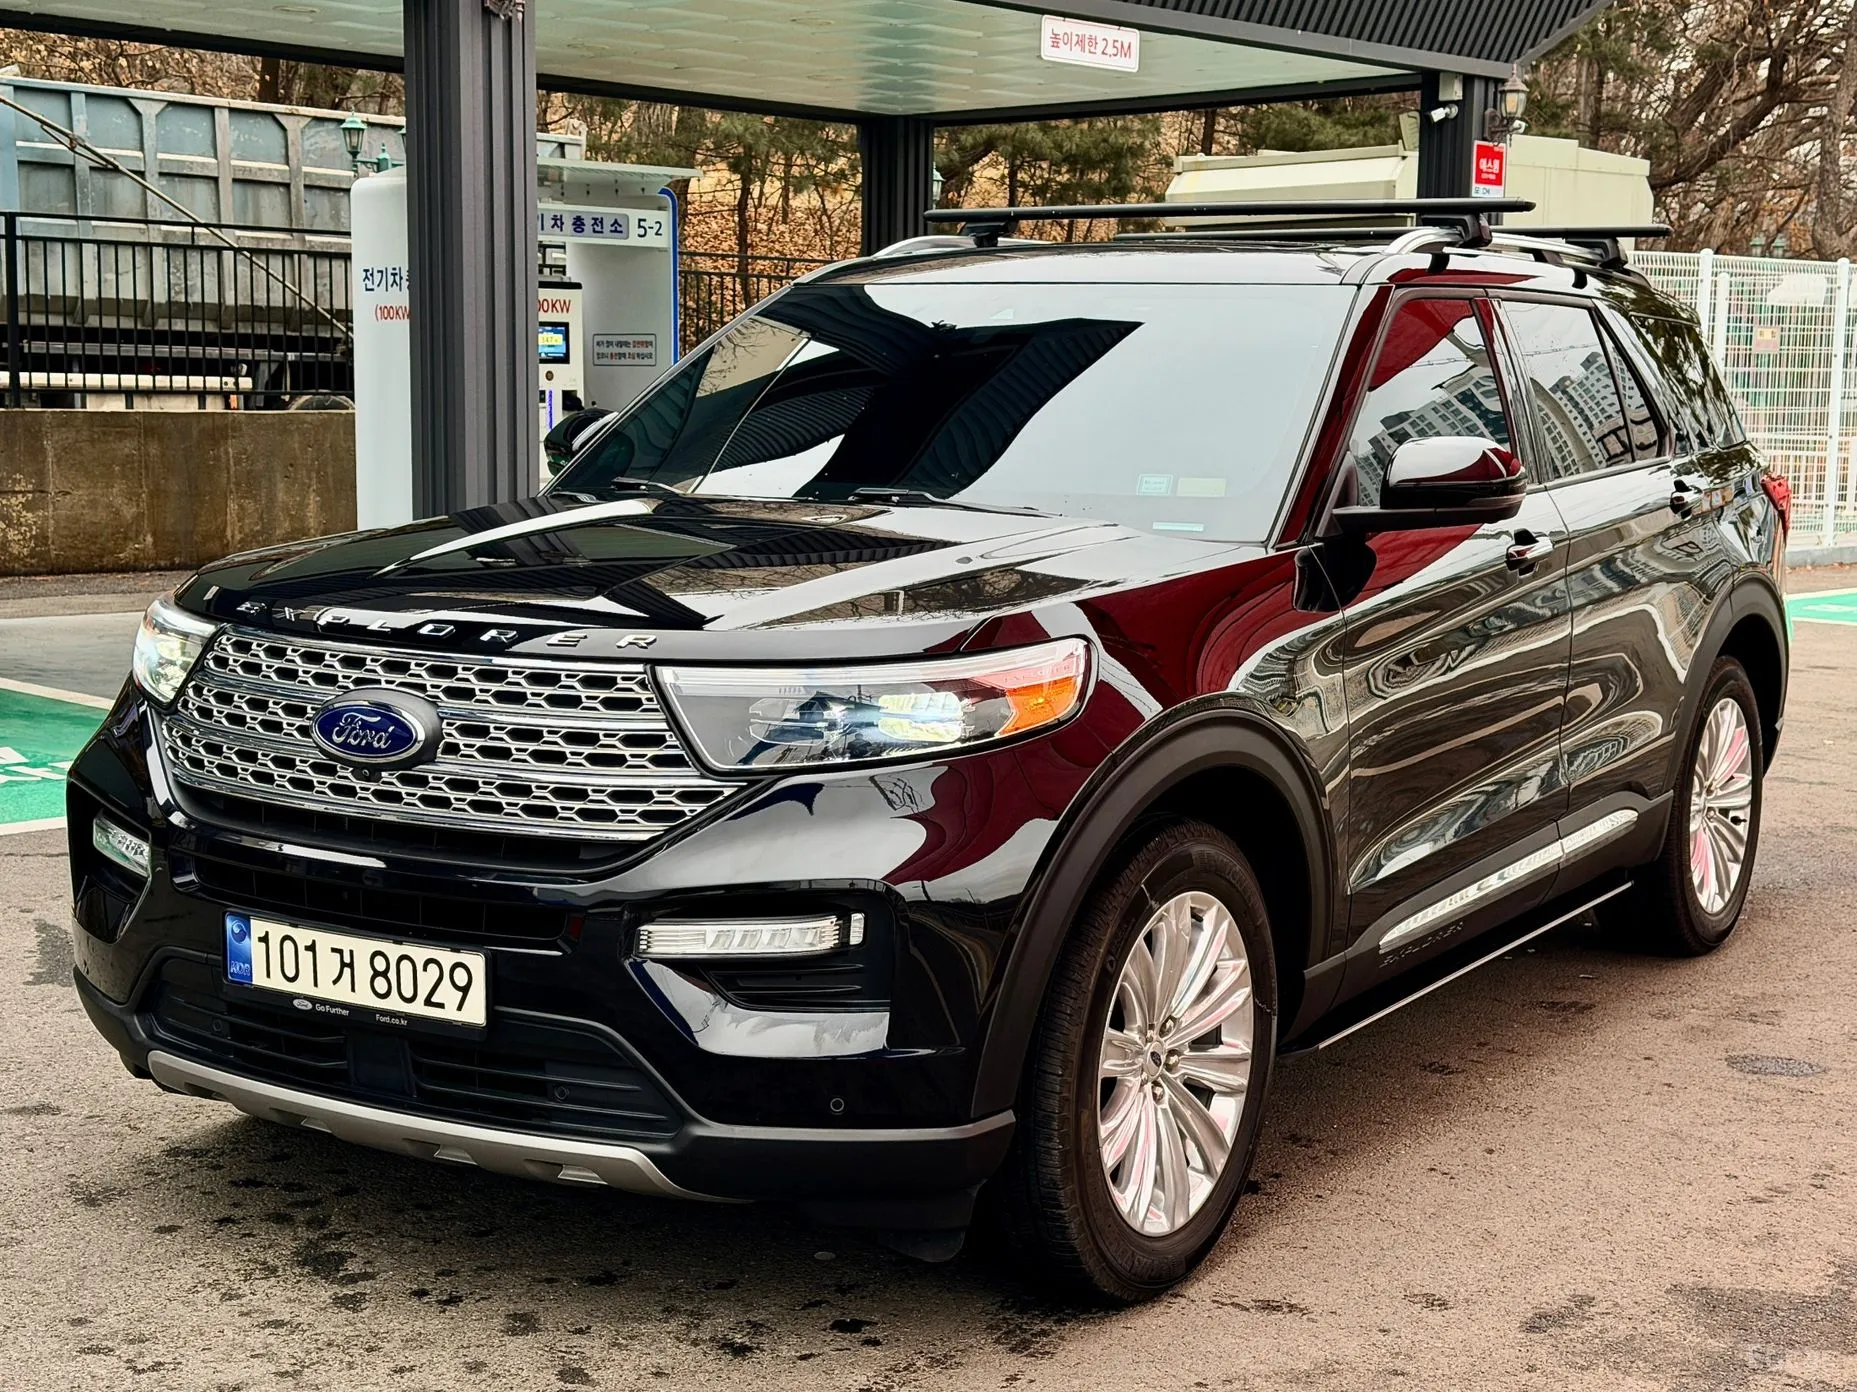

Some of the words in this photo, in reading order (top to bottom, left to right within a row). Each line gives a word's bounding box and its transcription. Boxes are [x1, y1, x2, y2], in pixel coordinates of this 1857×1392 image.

[1049, 27, 1098, 55] 높이제한
[1101, 37, 1132, 59] 2.5M
[637, 218, 663, 238] 5-2
[362, 266, 409, 292] 전기차
[236, 602, 657, 649] EXPLORER
[332, 712, 395, 749] Ford
[257, 930, 356, 994] 101거
[369, 949, 473, 1012] 8029
[315, 1003, 326, 1013] Go
[326, 1005, 350, 1017] Further
[375, 1013, 408, 1026] Ford.co.kr
